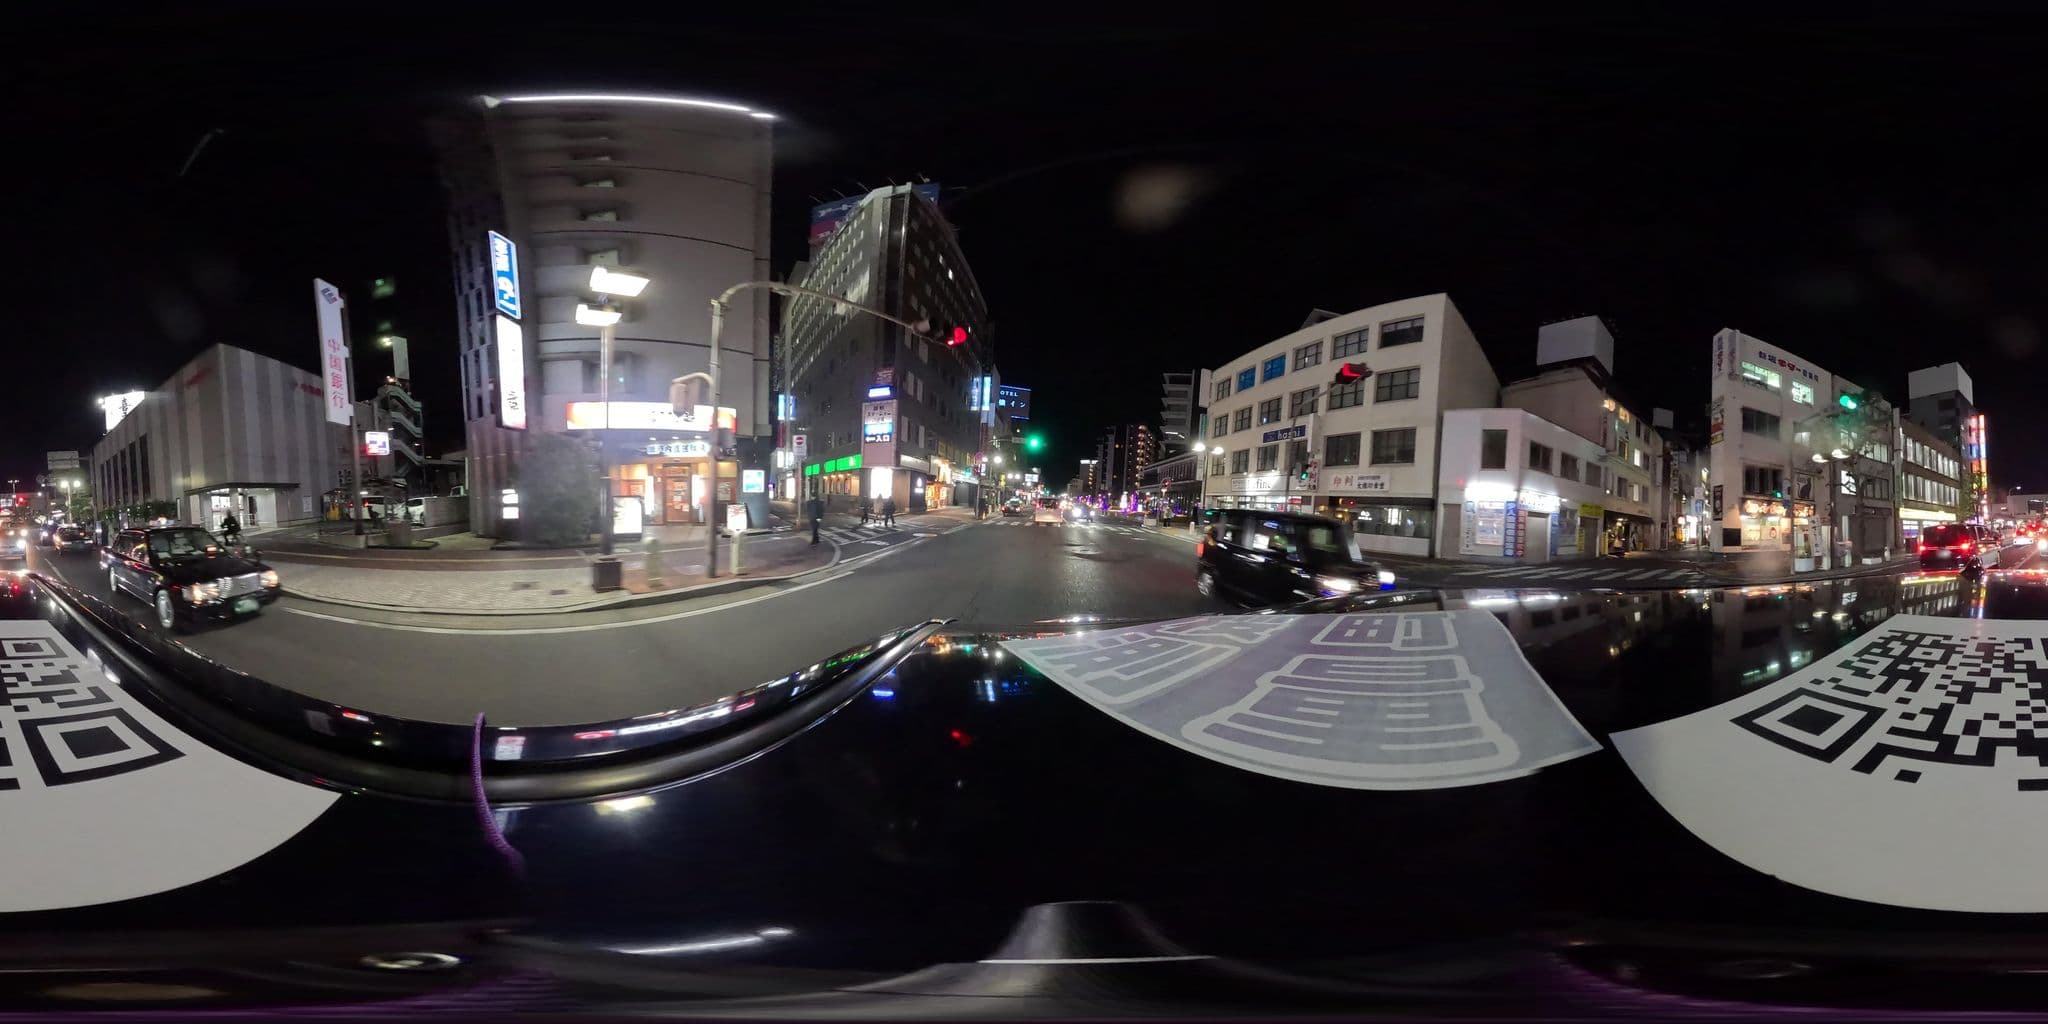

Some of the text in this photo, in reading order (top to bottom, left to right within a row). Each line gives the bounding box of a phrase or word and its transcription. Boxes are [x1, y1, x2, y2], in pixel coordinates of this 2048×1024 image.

[327, 338, 344, 409] 中国銀行
[875, 434, 890, 442] 入口
